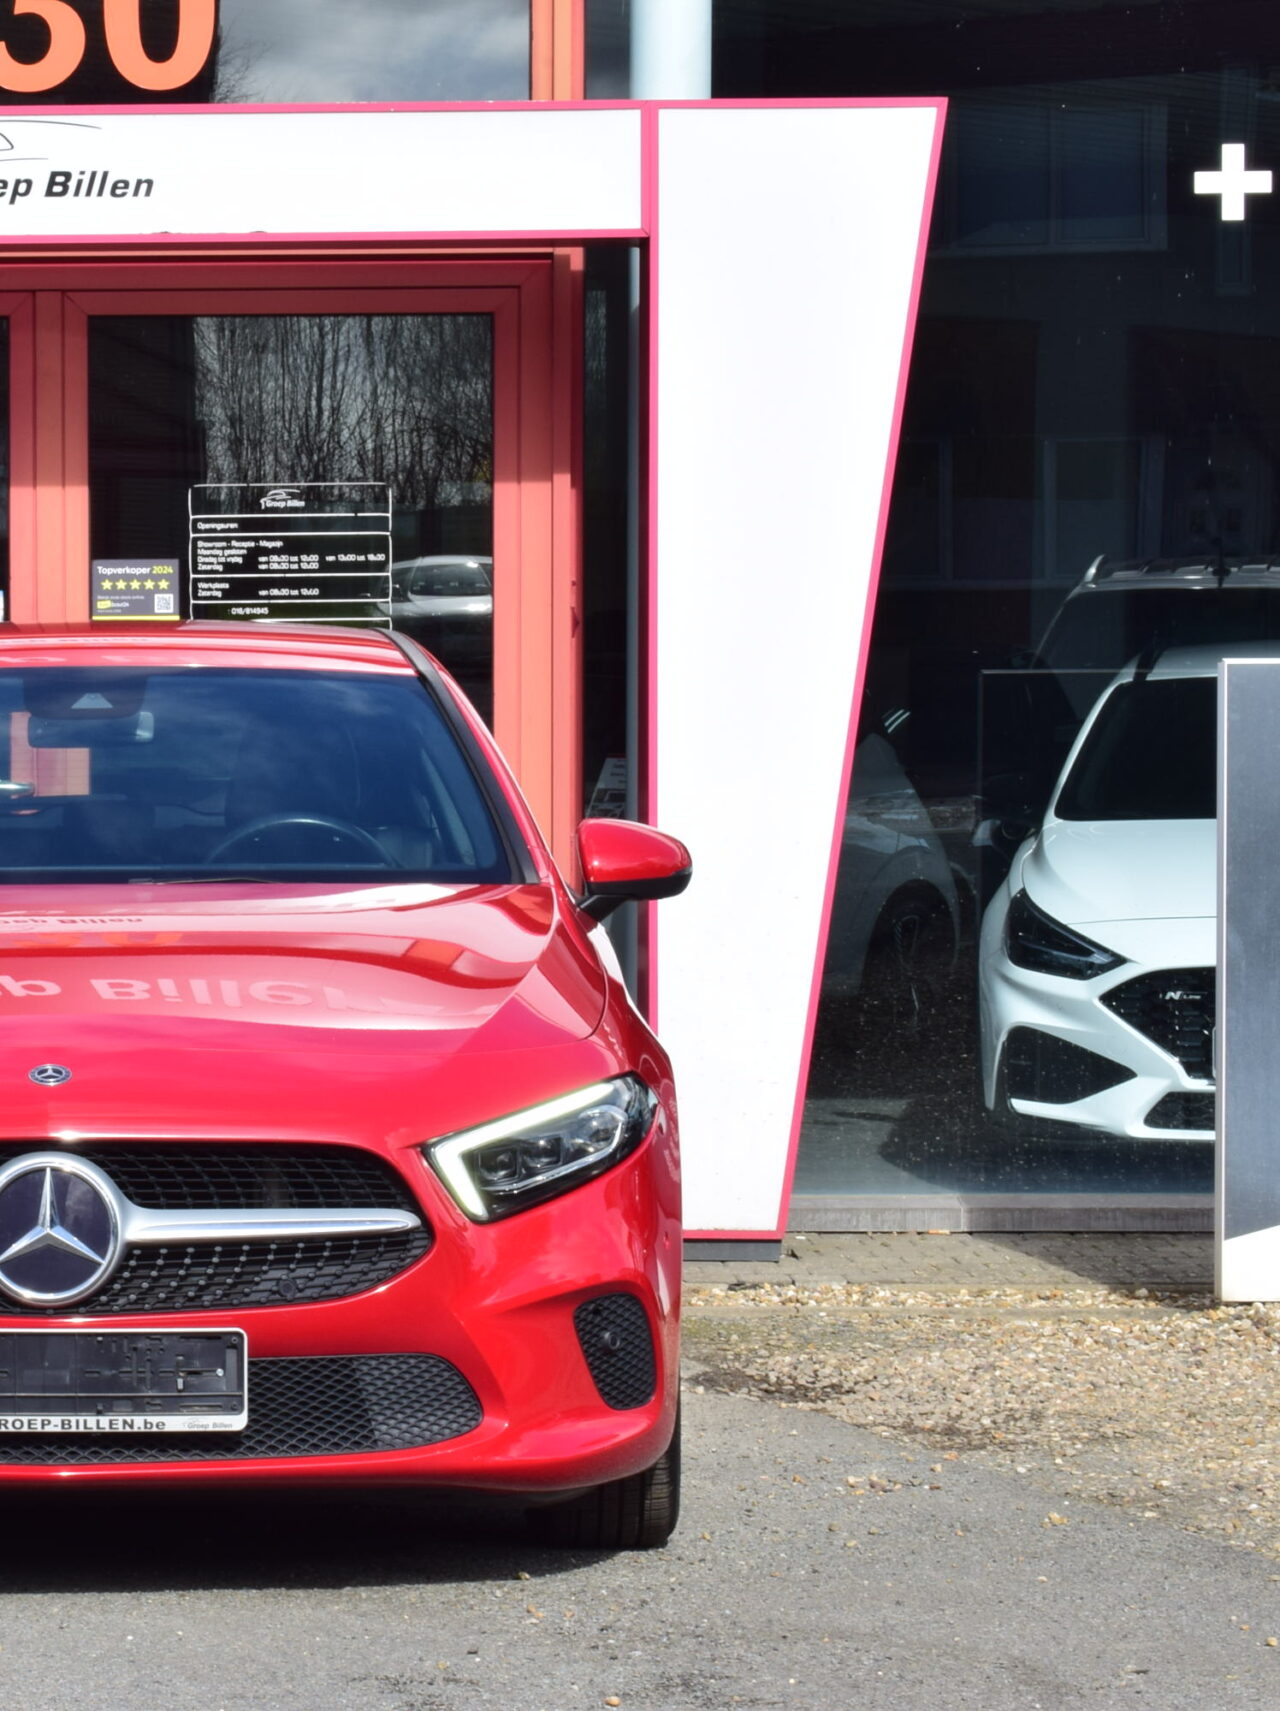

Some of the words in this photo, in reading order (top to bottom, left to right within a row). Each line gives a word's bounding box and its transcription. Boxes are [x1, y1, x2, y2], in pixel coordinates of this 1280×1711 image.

[44, 170, 155, 198] Billen
[265, 500, 286, 508] Groep
[197, 521, 238, 531] Openingsuren
[97, 566, 151, 575] Topverkoper
[152, 565, 174, 574] 2024
[187, 1421, 209, 1430] Groep
[212, 1421, 233, 1429] Billen
